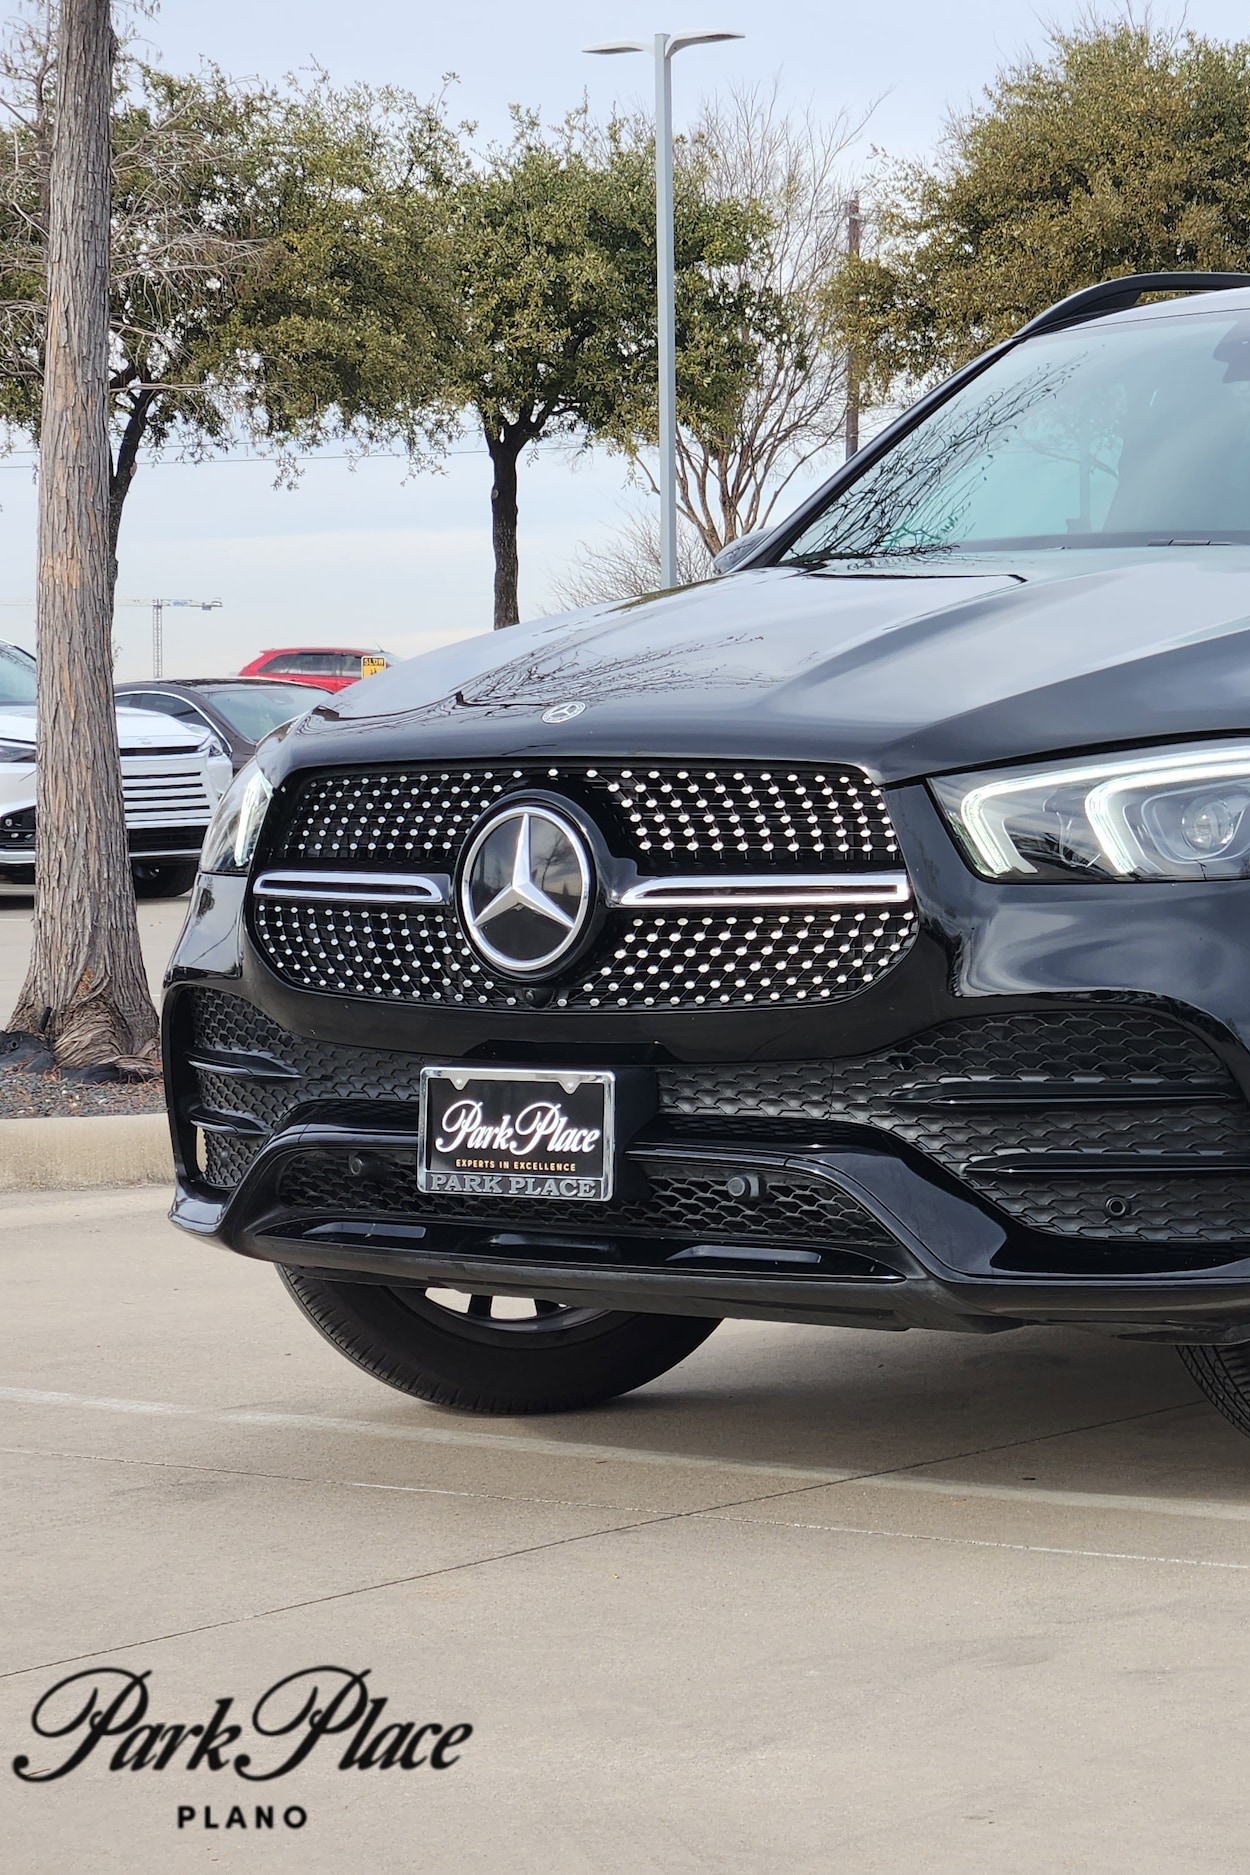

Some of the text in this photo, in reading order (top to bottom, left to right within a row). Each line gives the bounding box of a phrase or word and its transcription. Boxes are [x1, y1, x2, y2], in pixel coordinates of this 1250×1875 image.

[435, 1099, 601, 1156] Park Place
[456, 1158, 576, 1172] EXPERTS IN EXCELLENCE
[430, 1174, 596, 1198] PARK PLACE
